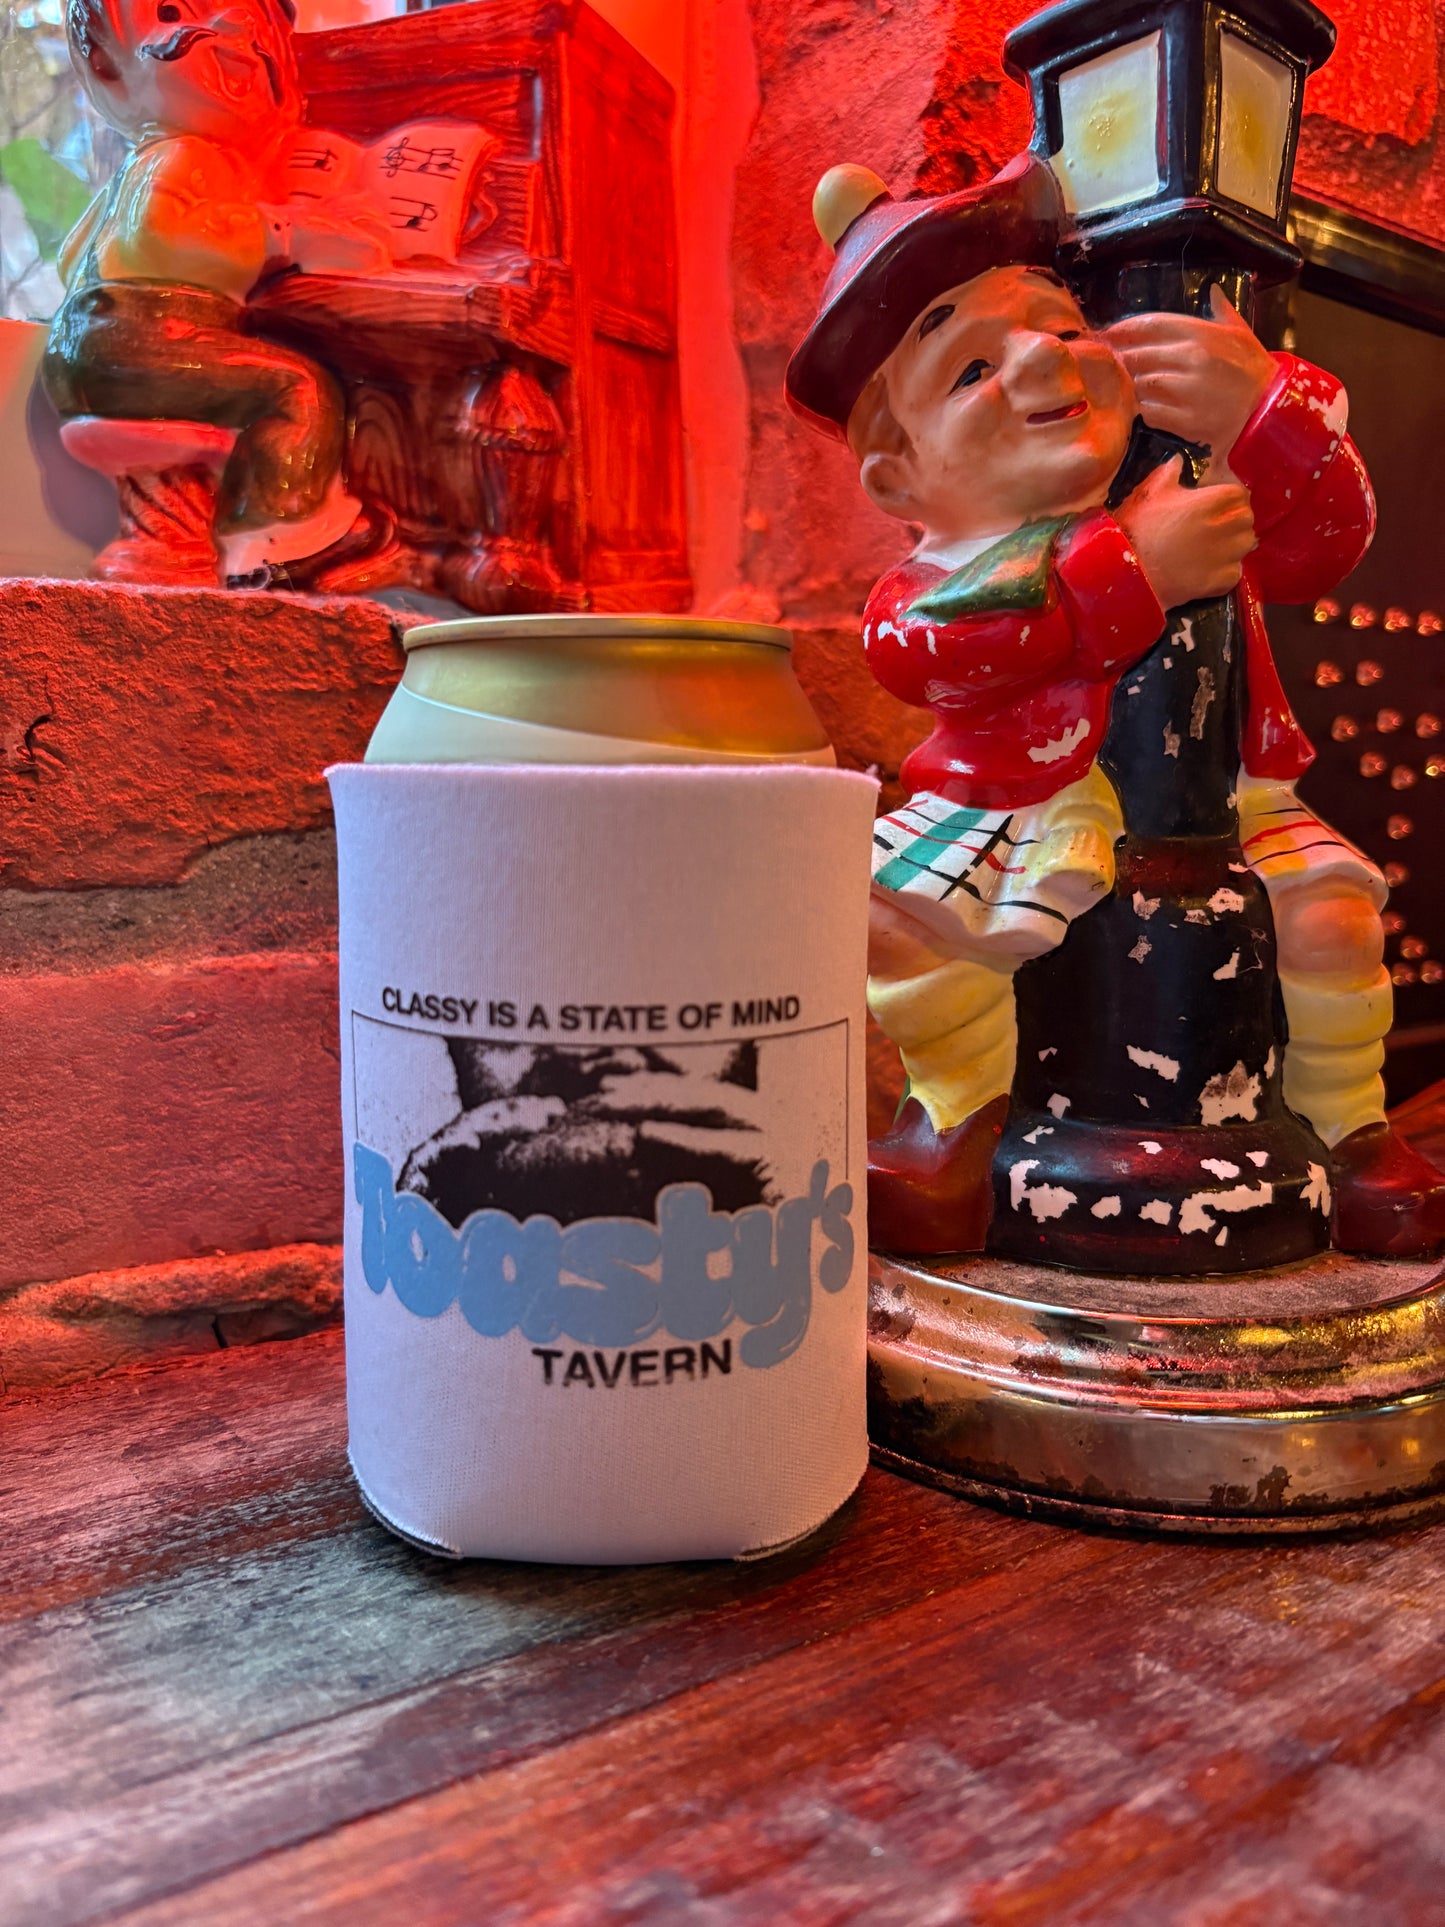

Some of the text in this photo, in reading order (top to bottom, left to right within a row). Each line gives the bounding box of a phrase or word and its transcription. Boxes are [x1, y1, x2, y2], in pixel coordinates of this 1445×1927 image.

[382, 986, 800, 1031] CLASSY IS A STATE OF MIND
[532, 1339, 732, 1389] TAVERN
